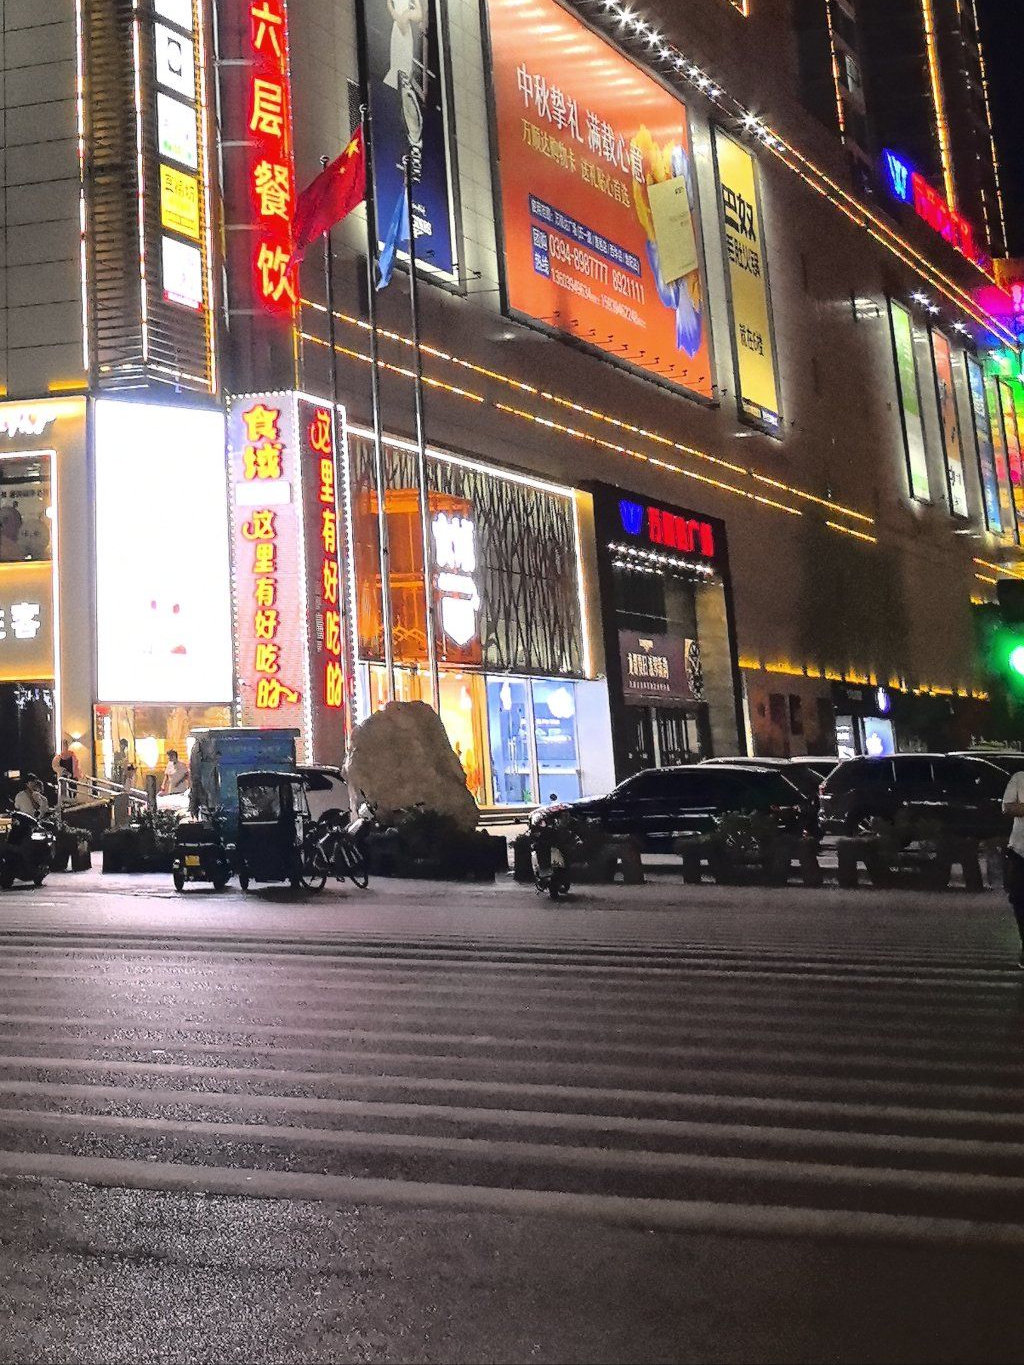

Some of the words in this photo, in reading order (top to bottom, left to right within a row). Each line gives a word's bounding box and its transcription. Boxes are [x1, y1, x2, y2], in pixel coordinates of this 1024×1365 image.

[517, 62, 584, 143] 中秋挚礼
[586, 109, 645, 183] 满载心意
[721, 183, 757, 242] 巴奴
[242, 509, 283, 709] 这里有好吃的
[309, 408, 344, 709] 这里有好吃的
